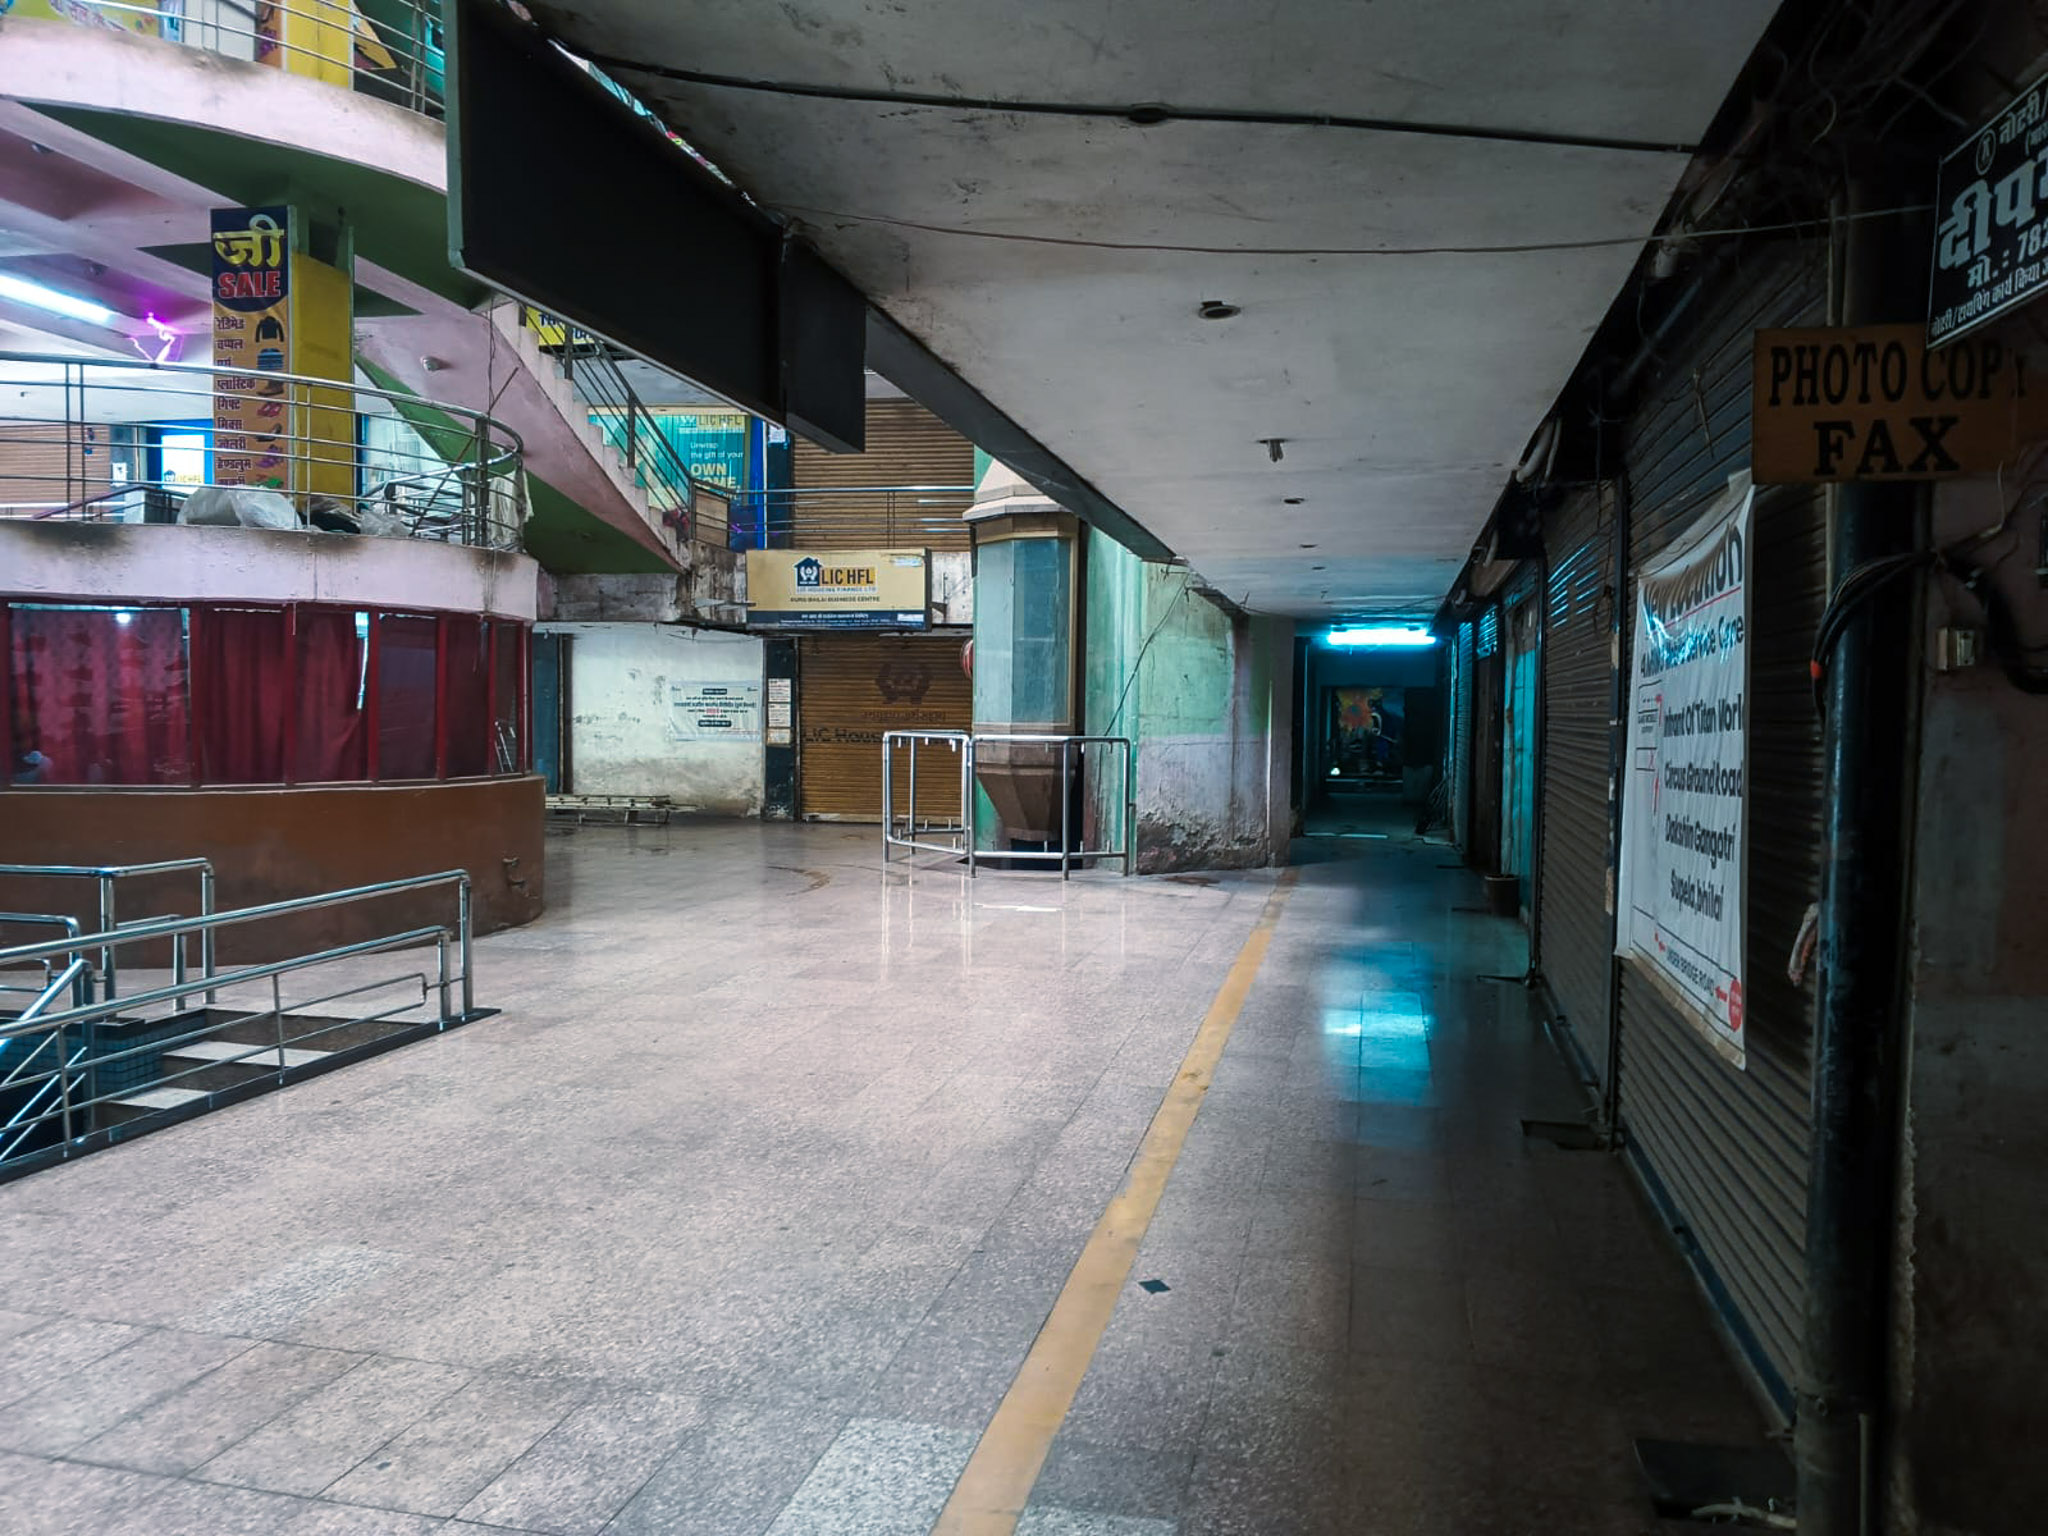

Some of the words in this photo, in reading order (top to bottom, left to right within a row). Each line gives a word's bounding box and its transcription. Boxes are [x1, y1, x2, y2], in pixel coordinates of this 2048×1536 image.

[213, 213, 285, 267] जी
[218, 270, 281, 299] SALE
[1768, 341, 1907, 406] PHOTO
[1922, 339, 2028, 401] COPY
[1813, 416, 1960, 476] FAX
[690, 463, 727, 476] OWN
[821, 569, 843, 585] LIC
[846, 569, 874, 585] HFL
[1695, 699, 1717, 735] Titan
[1718, 693, 1743, 732] Worl
[1664, 758, 1687, 790] Circus
[1687, 760, 1716, 795] Ground
[1664, 813, 1694, 850] Dakshin
[1694, 821, 1736, 870] Gangotri
